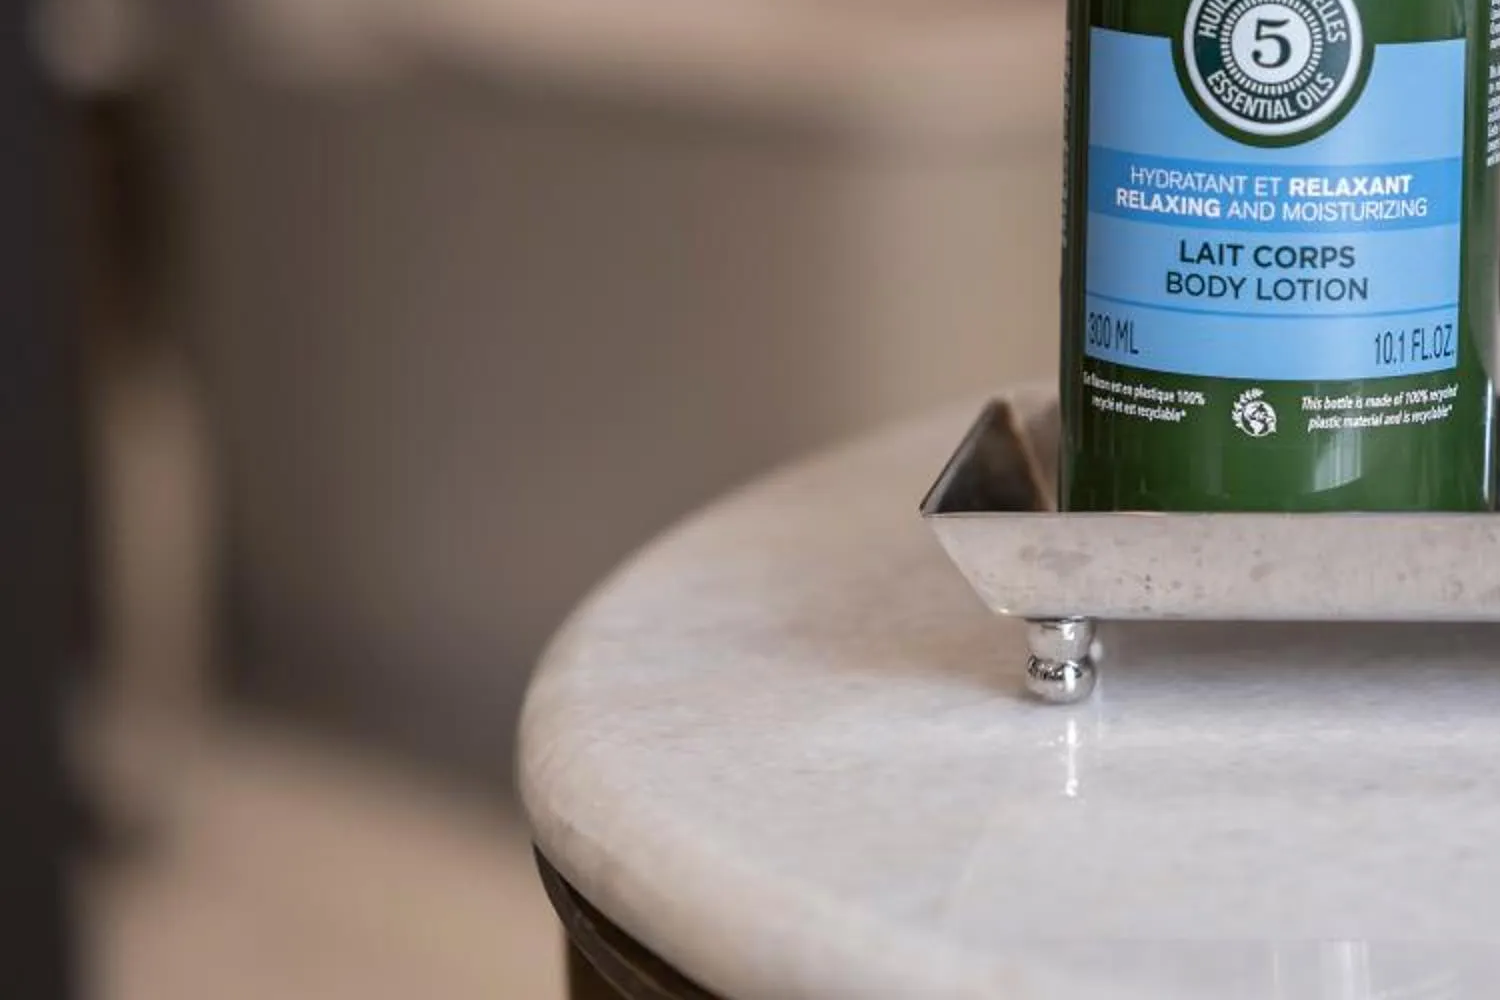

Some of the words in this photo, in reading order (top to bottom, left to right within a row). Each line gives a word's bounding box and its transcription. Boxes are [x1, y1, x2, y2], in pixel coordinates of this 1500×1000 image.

[1251, 18, 1293, 70] 5
[1206, 69, 1298, 121] ESSENTIAL
[1295, 71, 1336, 110] OILS
[1130, 165, 1249, 196] HYDRATANT
[1253, 175, 1283, 198] ET
[1288, 173, 1413, 198] RELAXANT
[1115, 186, 1222, 218] RELAXING
[1226, 199, 1276, 222] AND
[1281, 196, 1429, 224] MOISTURIZING
[1178, 238, 1246, 267] LAIT
[1252, 244, 1357, 270] CORPS
[1165, 270, 1248, 300] BODY
[1255, 276, 1370, 302] LOTION
[1087, 312, 1111, 351] 300
[1115, 319, 1140, 355] ML
[1374, 329, 1406, 366] 10.1
[1301, 395, 1323, 412] This
[1323, 395, 1351, 410] bottle
[1365, 393, 1393, 408] made
[1307, 415, 1342, 433] plastic
